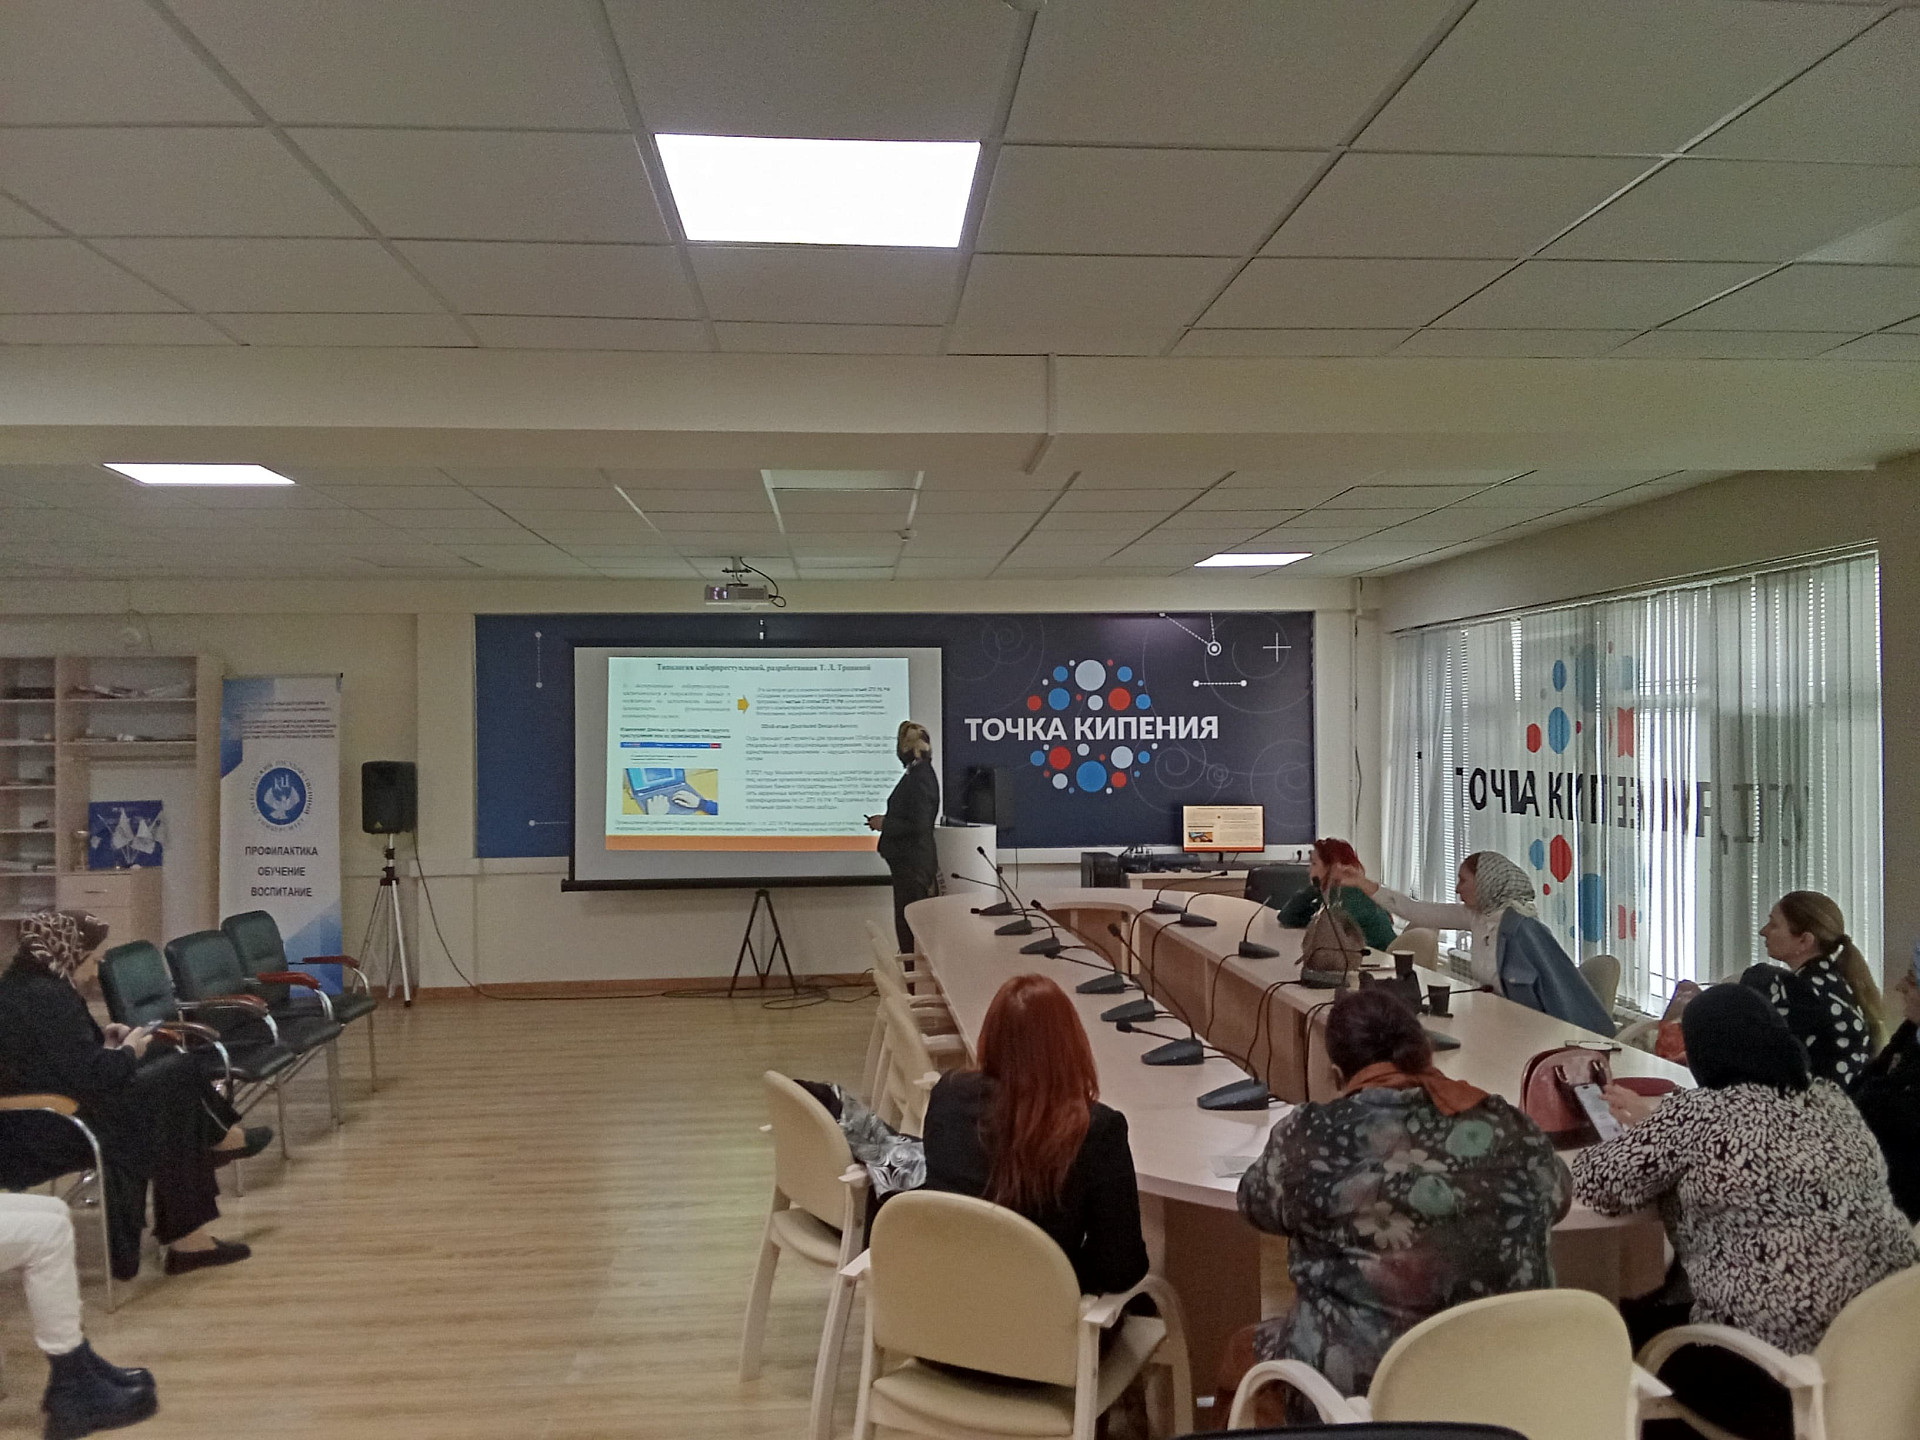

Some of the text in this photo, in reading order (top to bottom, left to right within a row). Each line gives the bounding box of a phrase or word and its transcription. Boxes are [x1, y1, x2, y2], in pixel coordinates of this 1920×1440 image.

[964, 716, 1218, 741] ТОЧКА КИПЕНИЯ
[244, 846, 319, 856] ПРОФИЛАКТИКА
[257, 866, 306, 876] ОБУЧЕНИЕ
[250, 887, 313, 897] ВОСПИТАНИЕ
